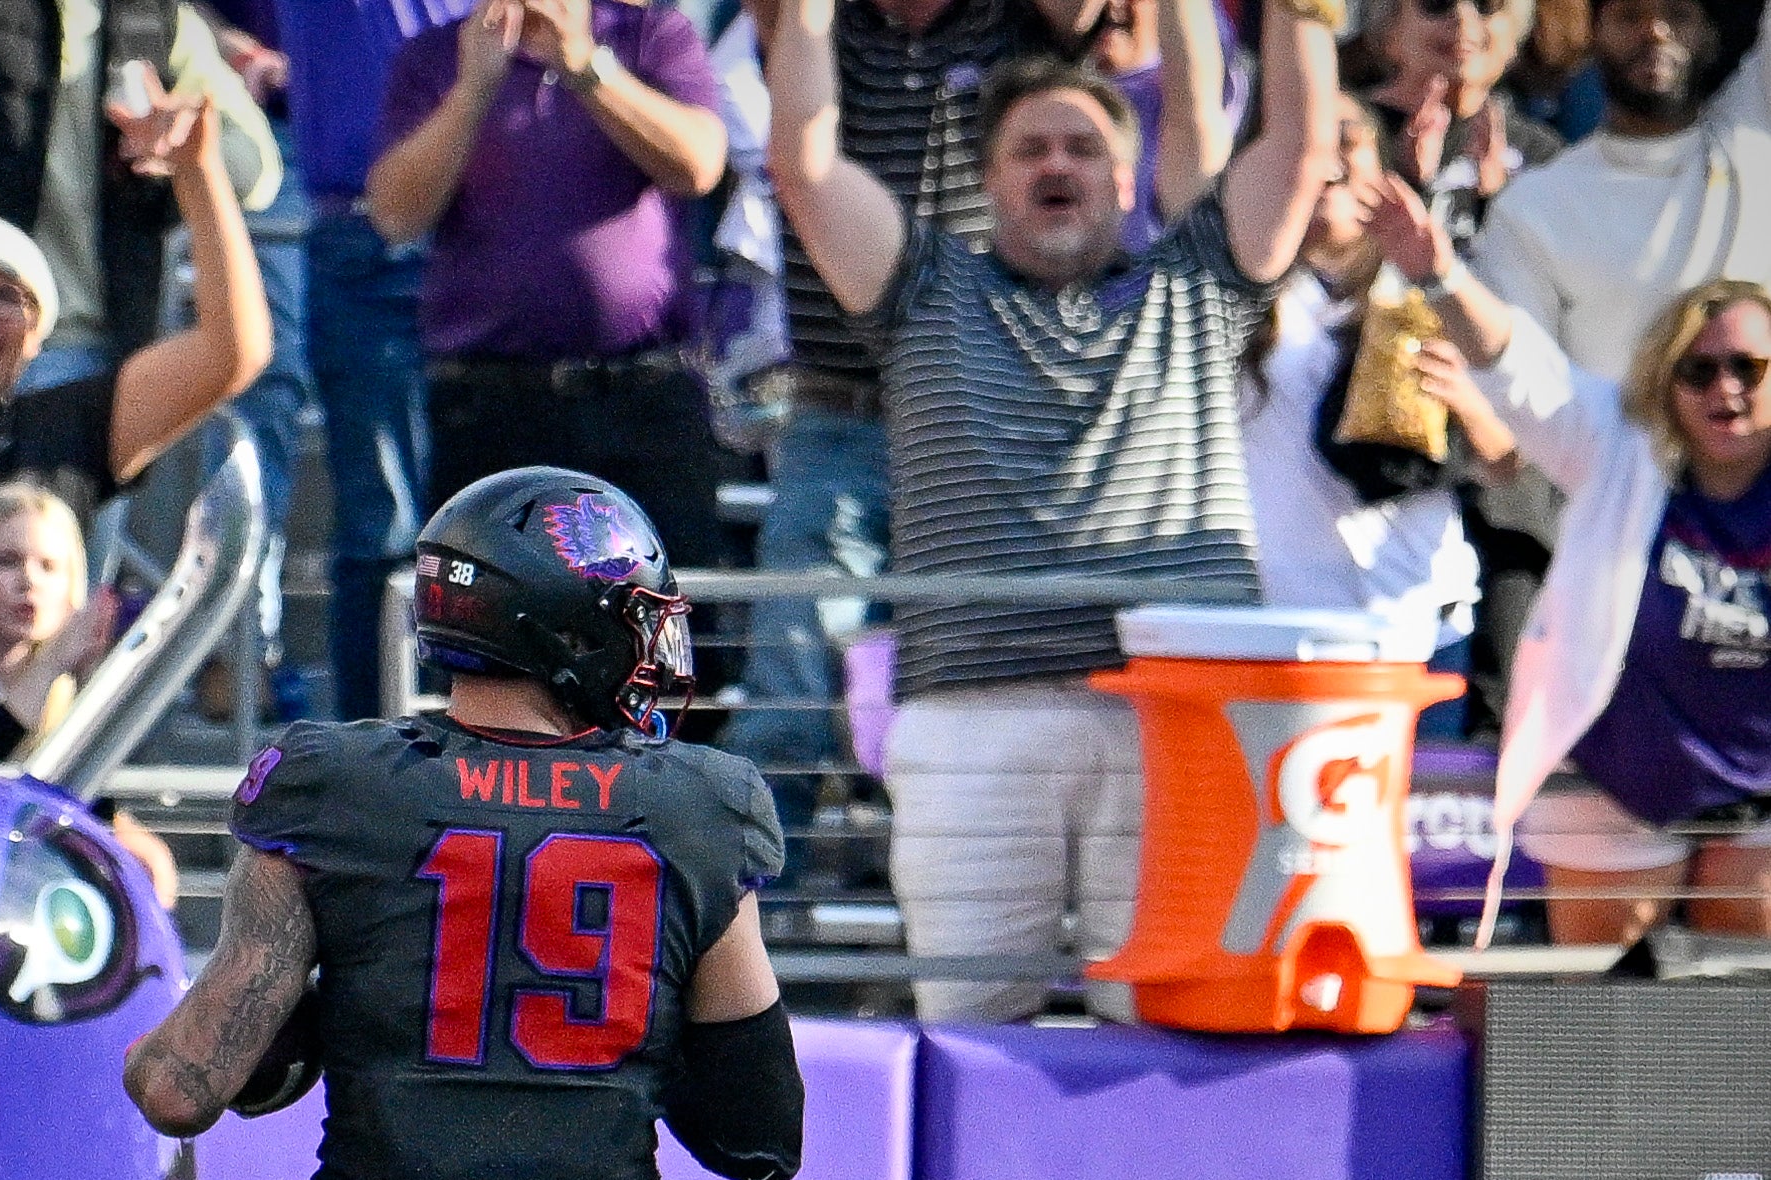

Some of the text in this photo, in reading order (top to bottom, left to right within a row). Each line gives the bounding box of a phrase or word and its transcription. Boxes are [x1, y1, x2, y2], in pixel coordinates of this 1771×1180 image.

[448, 560, 475, 586] 38
[455, 757, 623, 811] WILEY
[1273, 714, 1393, 846] G
[415, 828, 665, 1071] 19
